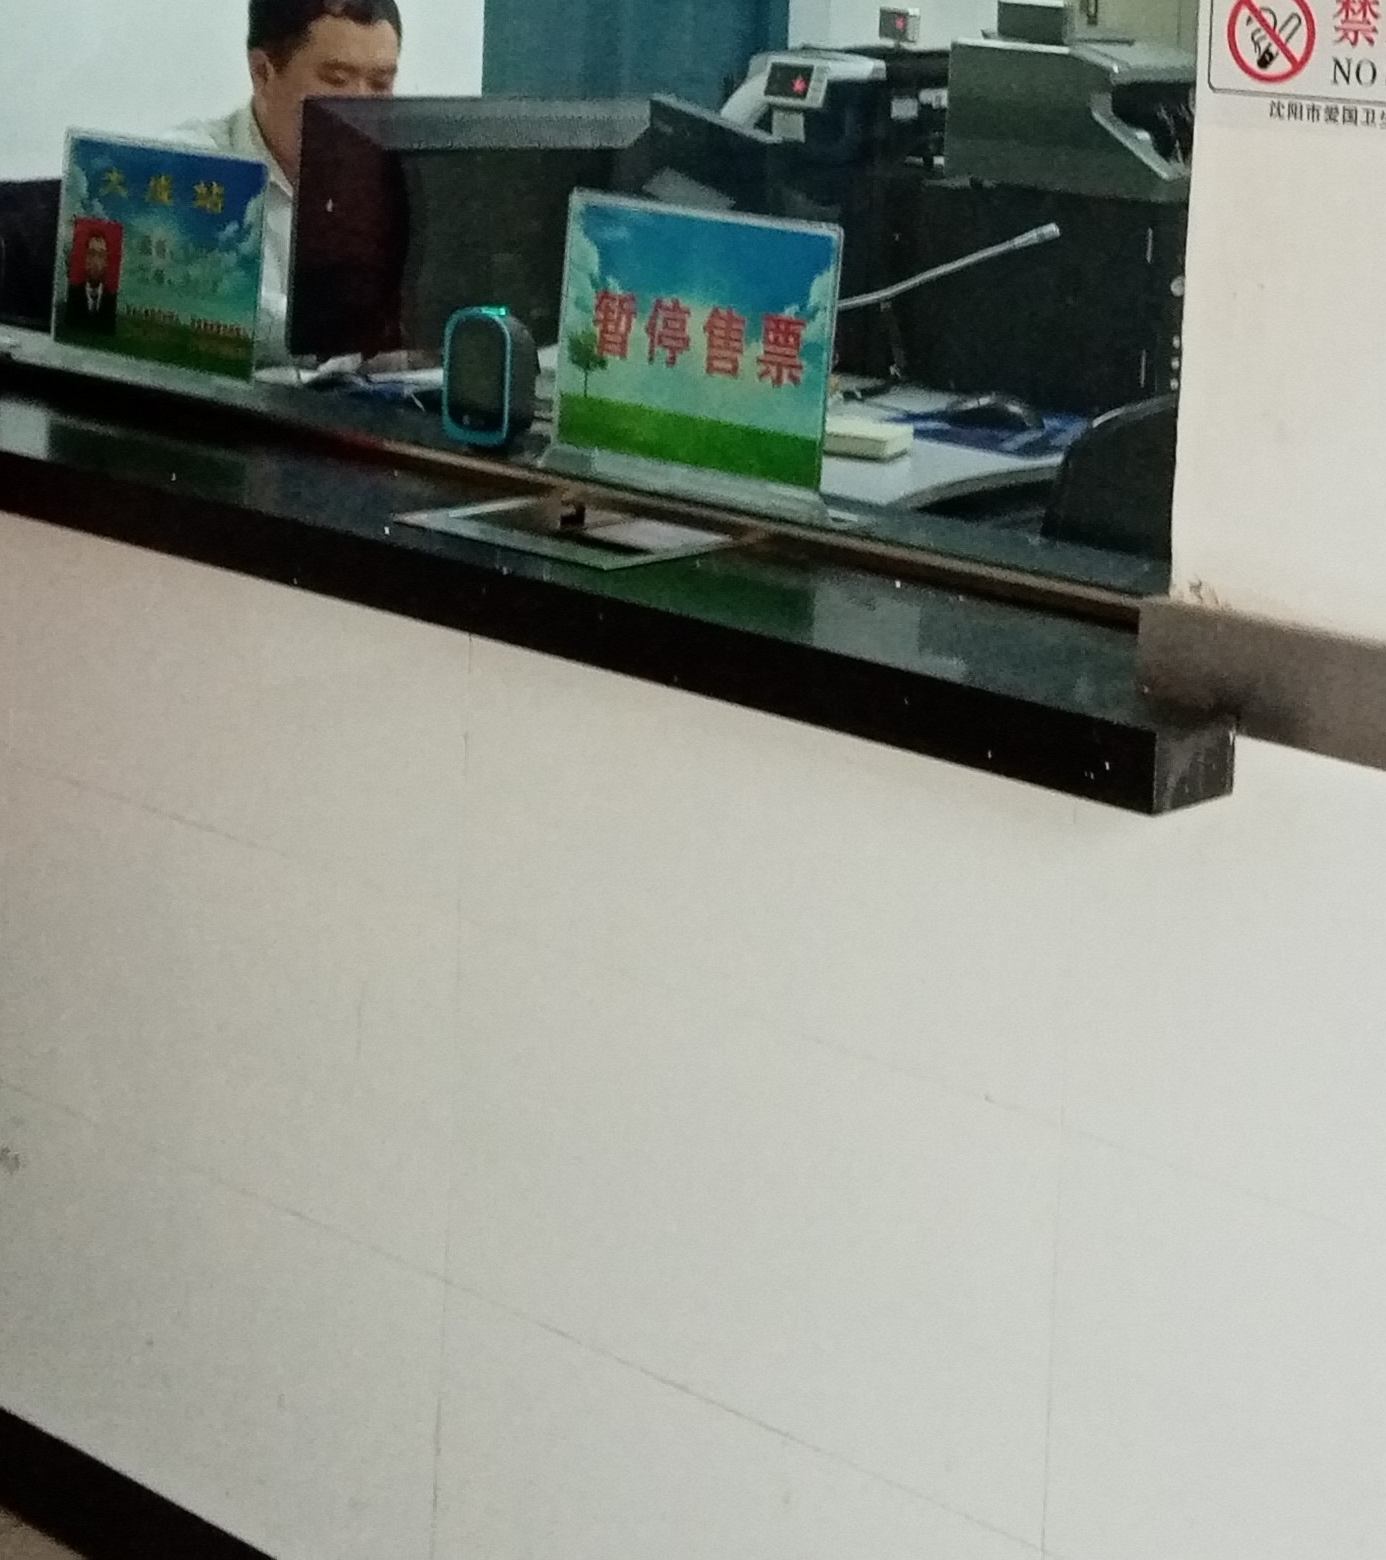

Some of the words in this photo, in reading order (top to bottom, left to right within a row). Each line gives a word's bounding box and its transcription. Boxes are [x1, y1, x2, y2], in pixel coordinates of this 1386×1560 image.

[1330, 56, 1378, 88] NO
[593, 290, 807, 387] 暂停售票
